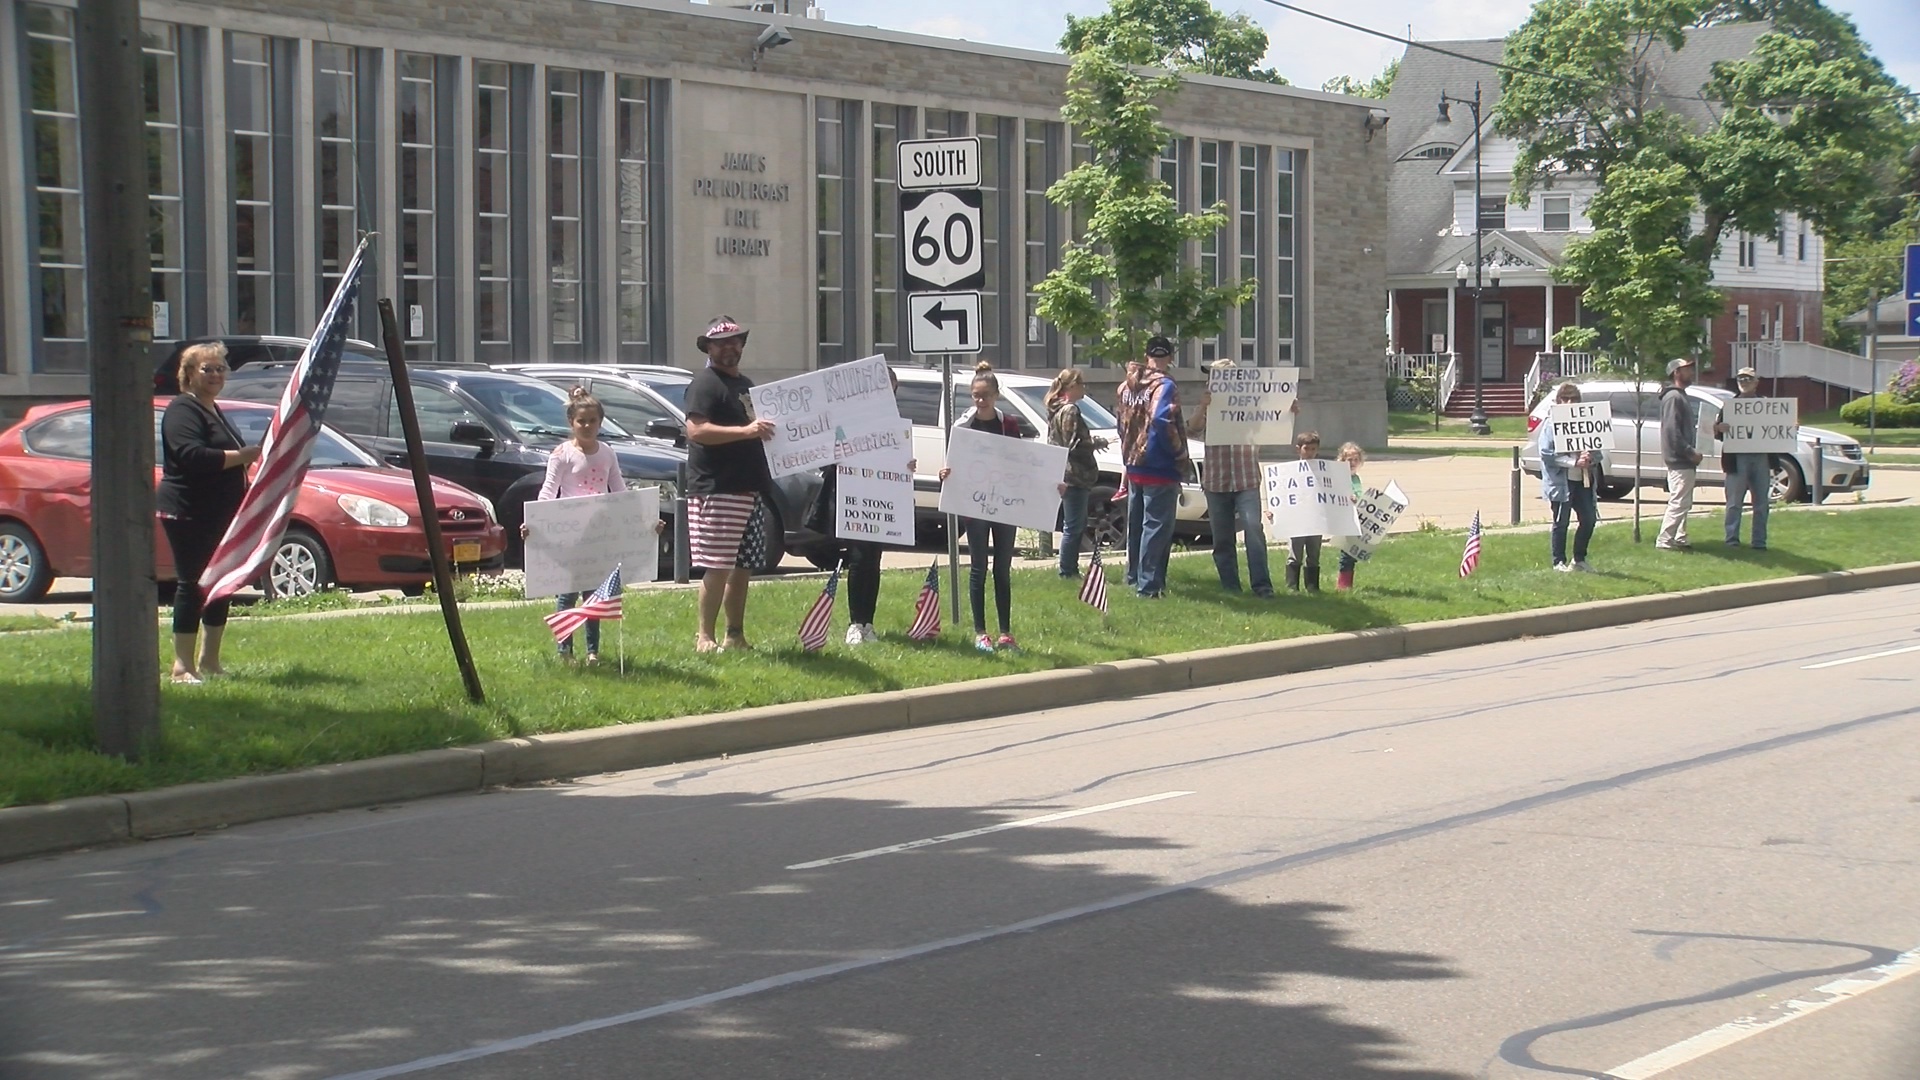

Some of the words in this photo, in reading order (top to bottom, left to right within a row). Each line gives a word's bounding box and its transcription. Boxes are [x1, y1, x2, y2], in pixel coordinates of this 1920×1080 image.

[721, 152, 766, 173] JAMES
[913, 149, 967, 177] SOUTH
[912, 212, 974, 266] 60
[715, 237, 771, 257] LIBRARY
[1211, 369, 1261, 380] DEFEND
[1210, 382, 1298, 393] CONSTITUTION
[760, 385, 813, 420] Stop
[1228, 396, 1261, 407] DEFY
[1734, 401, 1789, 415] REOPEN
[1221, 410, 1281, 421] TYRANNY
[1570, 406, 1594, 418] LET
[1554, 420, 1612, 436] FREEDOM
[1726, 425, 1754, 439] NEW
[1761, 425, 1794, 439] YORK
[1566, 437, 1602, 451] RING
[861, 468, 874, 478] UP
[1365, 487, 1383, 500] MY
[845, 496, 857, 505] BE
[862, 498, 894, 510] STONG
[845, 509, 859, 518] DO
[861, 511, 882, 521] NOT
[884, 514, 896, 523] BE
[1357, 509, 1385, 536] HERE
[844, 521, 880, 534] AFRAID
